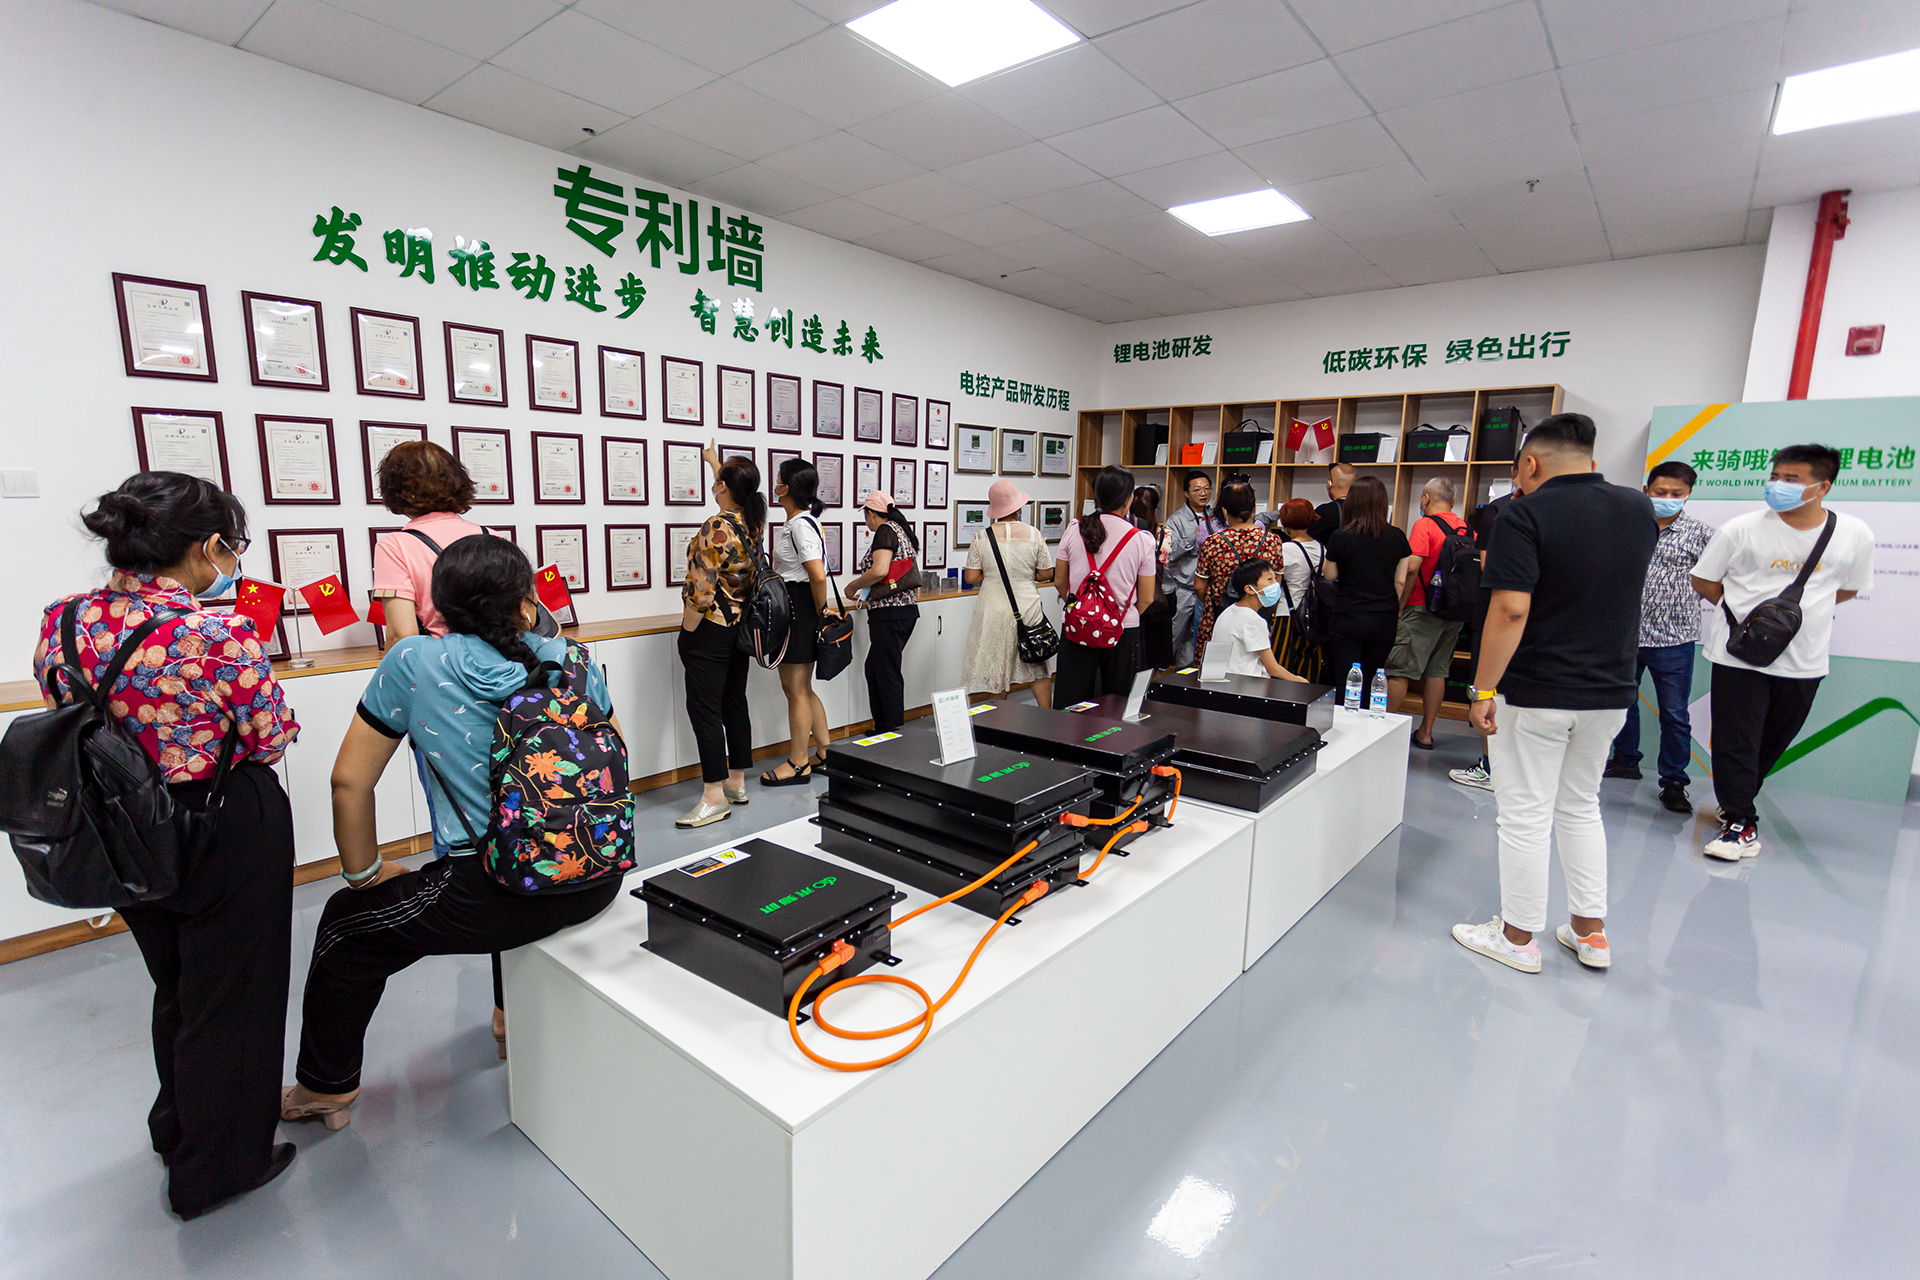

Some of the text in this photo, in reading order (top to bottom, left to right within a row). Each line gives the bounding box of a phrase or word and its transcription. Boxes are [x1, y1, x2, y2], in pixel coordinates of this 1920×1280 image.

[553, 164, 765, 293] 专利墙
[311, 205, 885, 365] 发明推动进步 智慧创造未来
[1113, 334, 1214, 364] 锂电池研发
[1322, 330, 1572, 375] 低碳环保 绿色出行
[959, 370, 1071, 412] 电控产品研发历程
[1690, 445, 1917, 472] 来骑哦锂电池
[1706, 479, 1742, 487] WORLD
[1862, 478, 1913, 487] BATTERY
